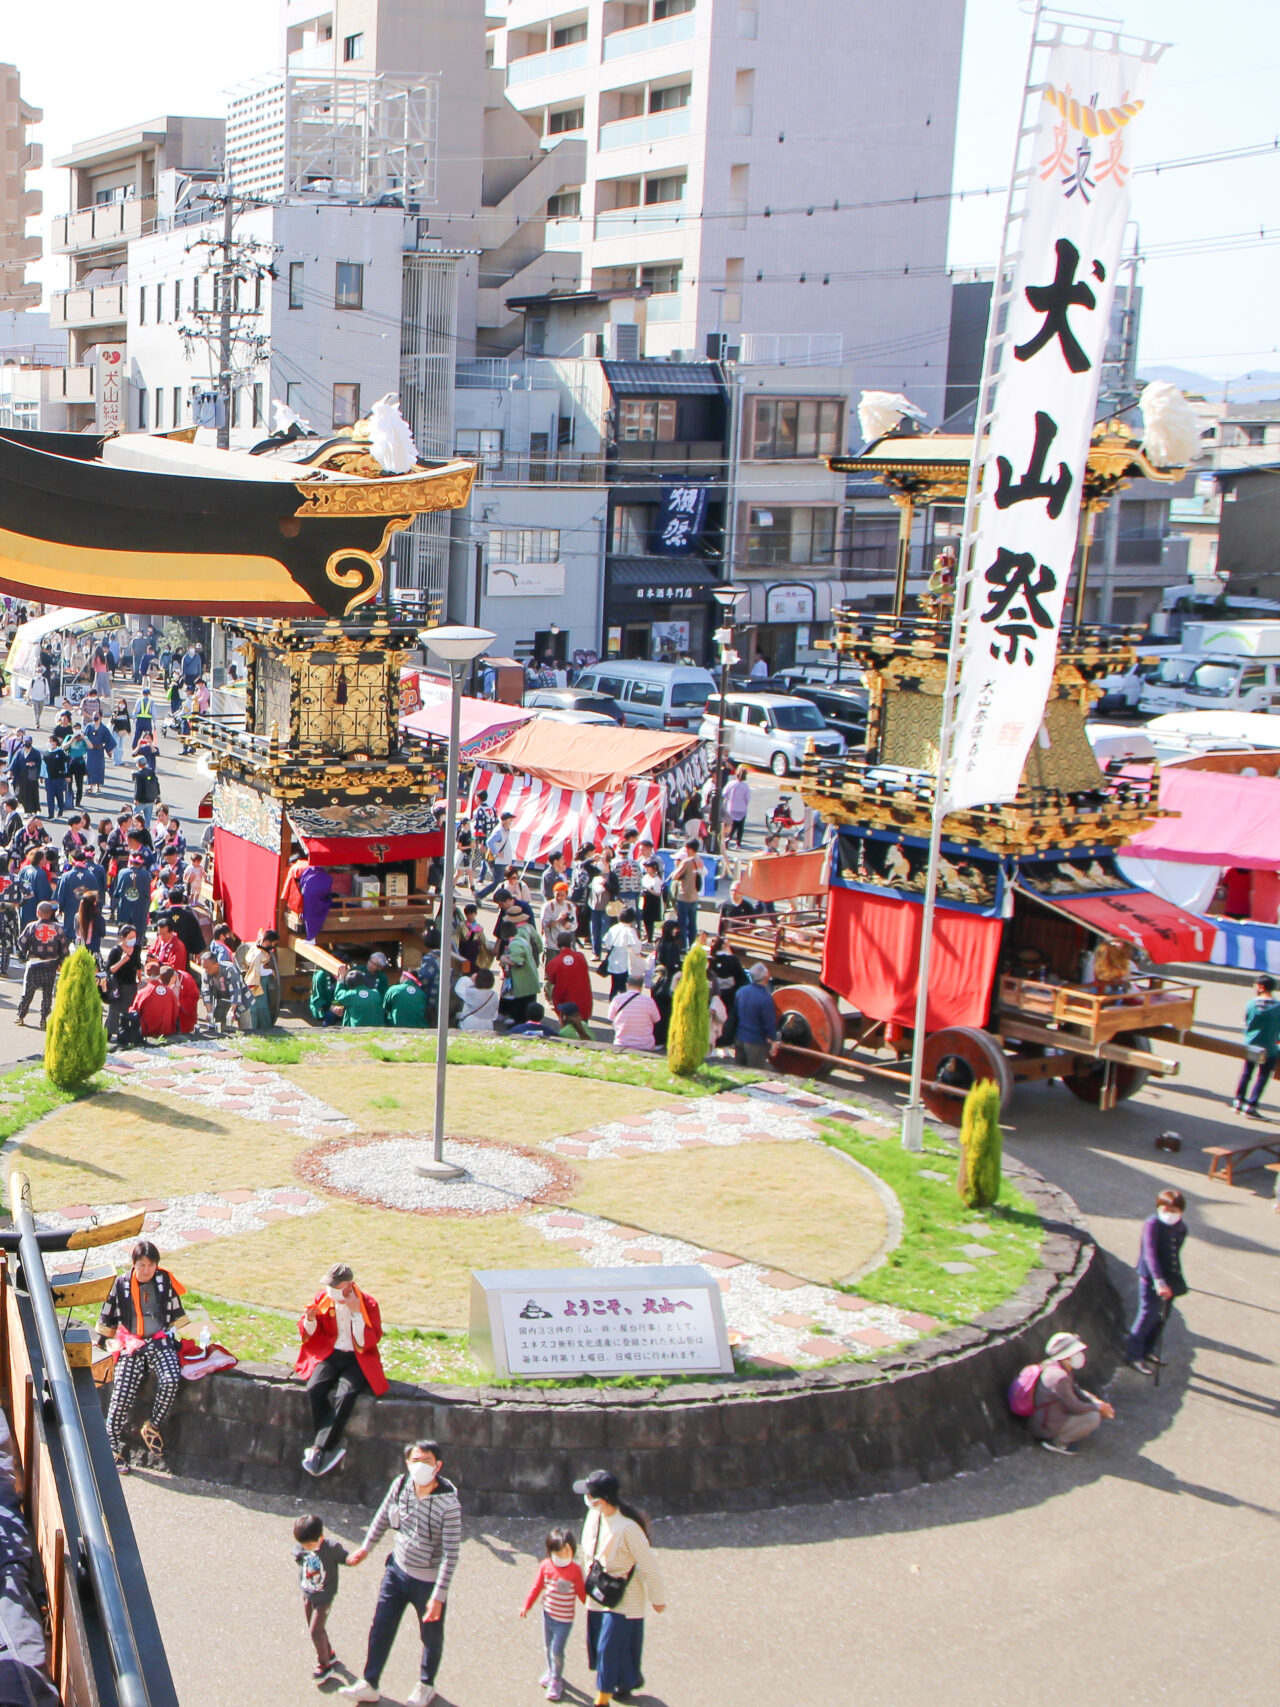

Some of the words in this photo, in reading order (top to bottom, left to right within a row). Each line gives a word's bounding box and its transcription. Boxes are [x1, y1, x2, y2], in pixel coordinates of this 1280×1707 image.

[980, 237, 1107, 668] 犬山祭
[662, 488, 699, 546] 獺祭
[636, 588, 693, 598] 日本酒専門店
[966, 679, 997, 772] 犬山祭保存会
[563, 1297, 693, 1317] ようこそ、犬山へ
